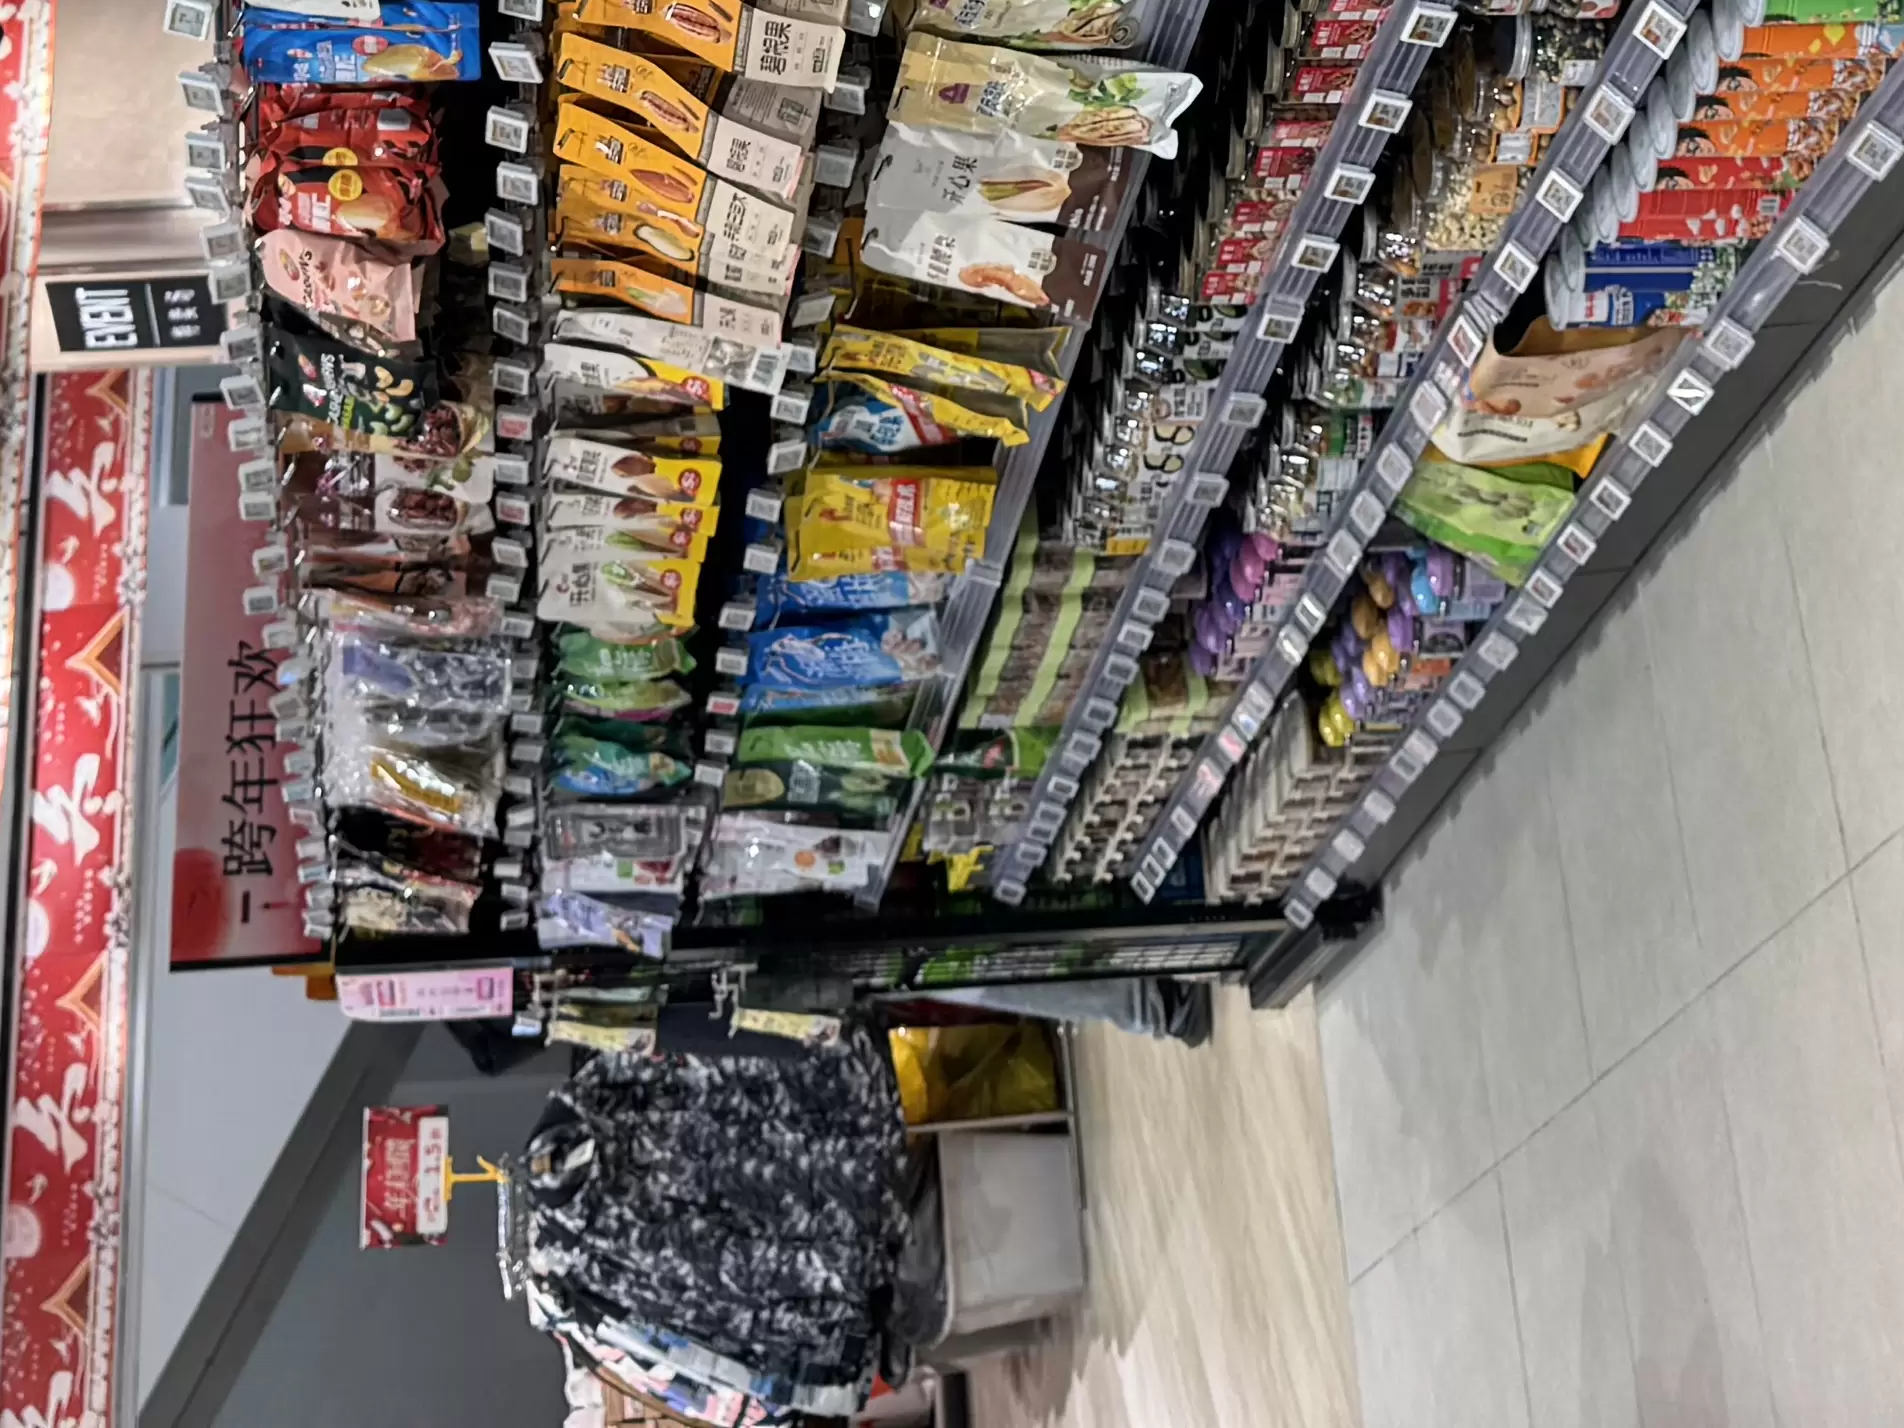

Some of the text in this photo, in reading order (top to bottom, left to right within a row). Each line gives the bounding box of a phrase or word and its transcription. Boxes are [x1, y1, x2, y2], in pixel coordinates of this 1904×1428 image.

[75, 287, 139, 349] EVENT
[222, 638, 278, 878] 跨年狂欢
